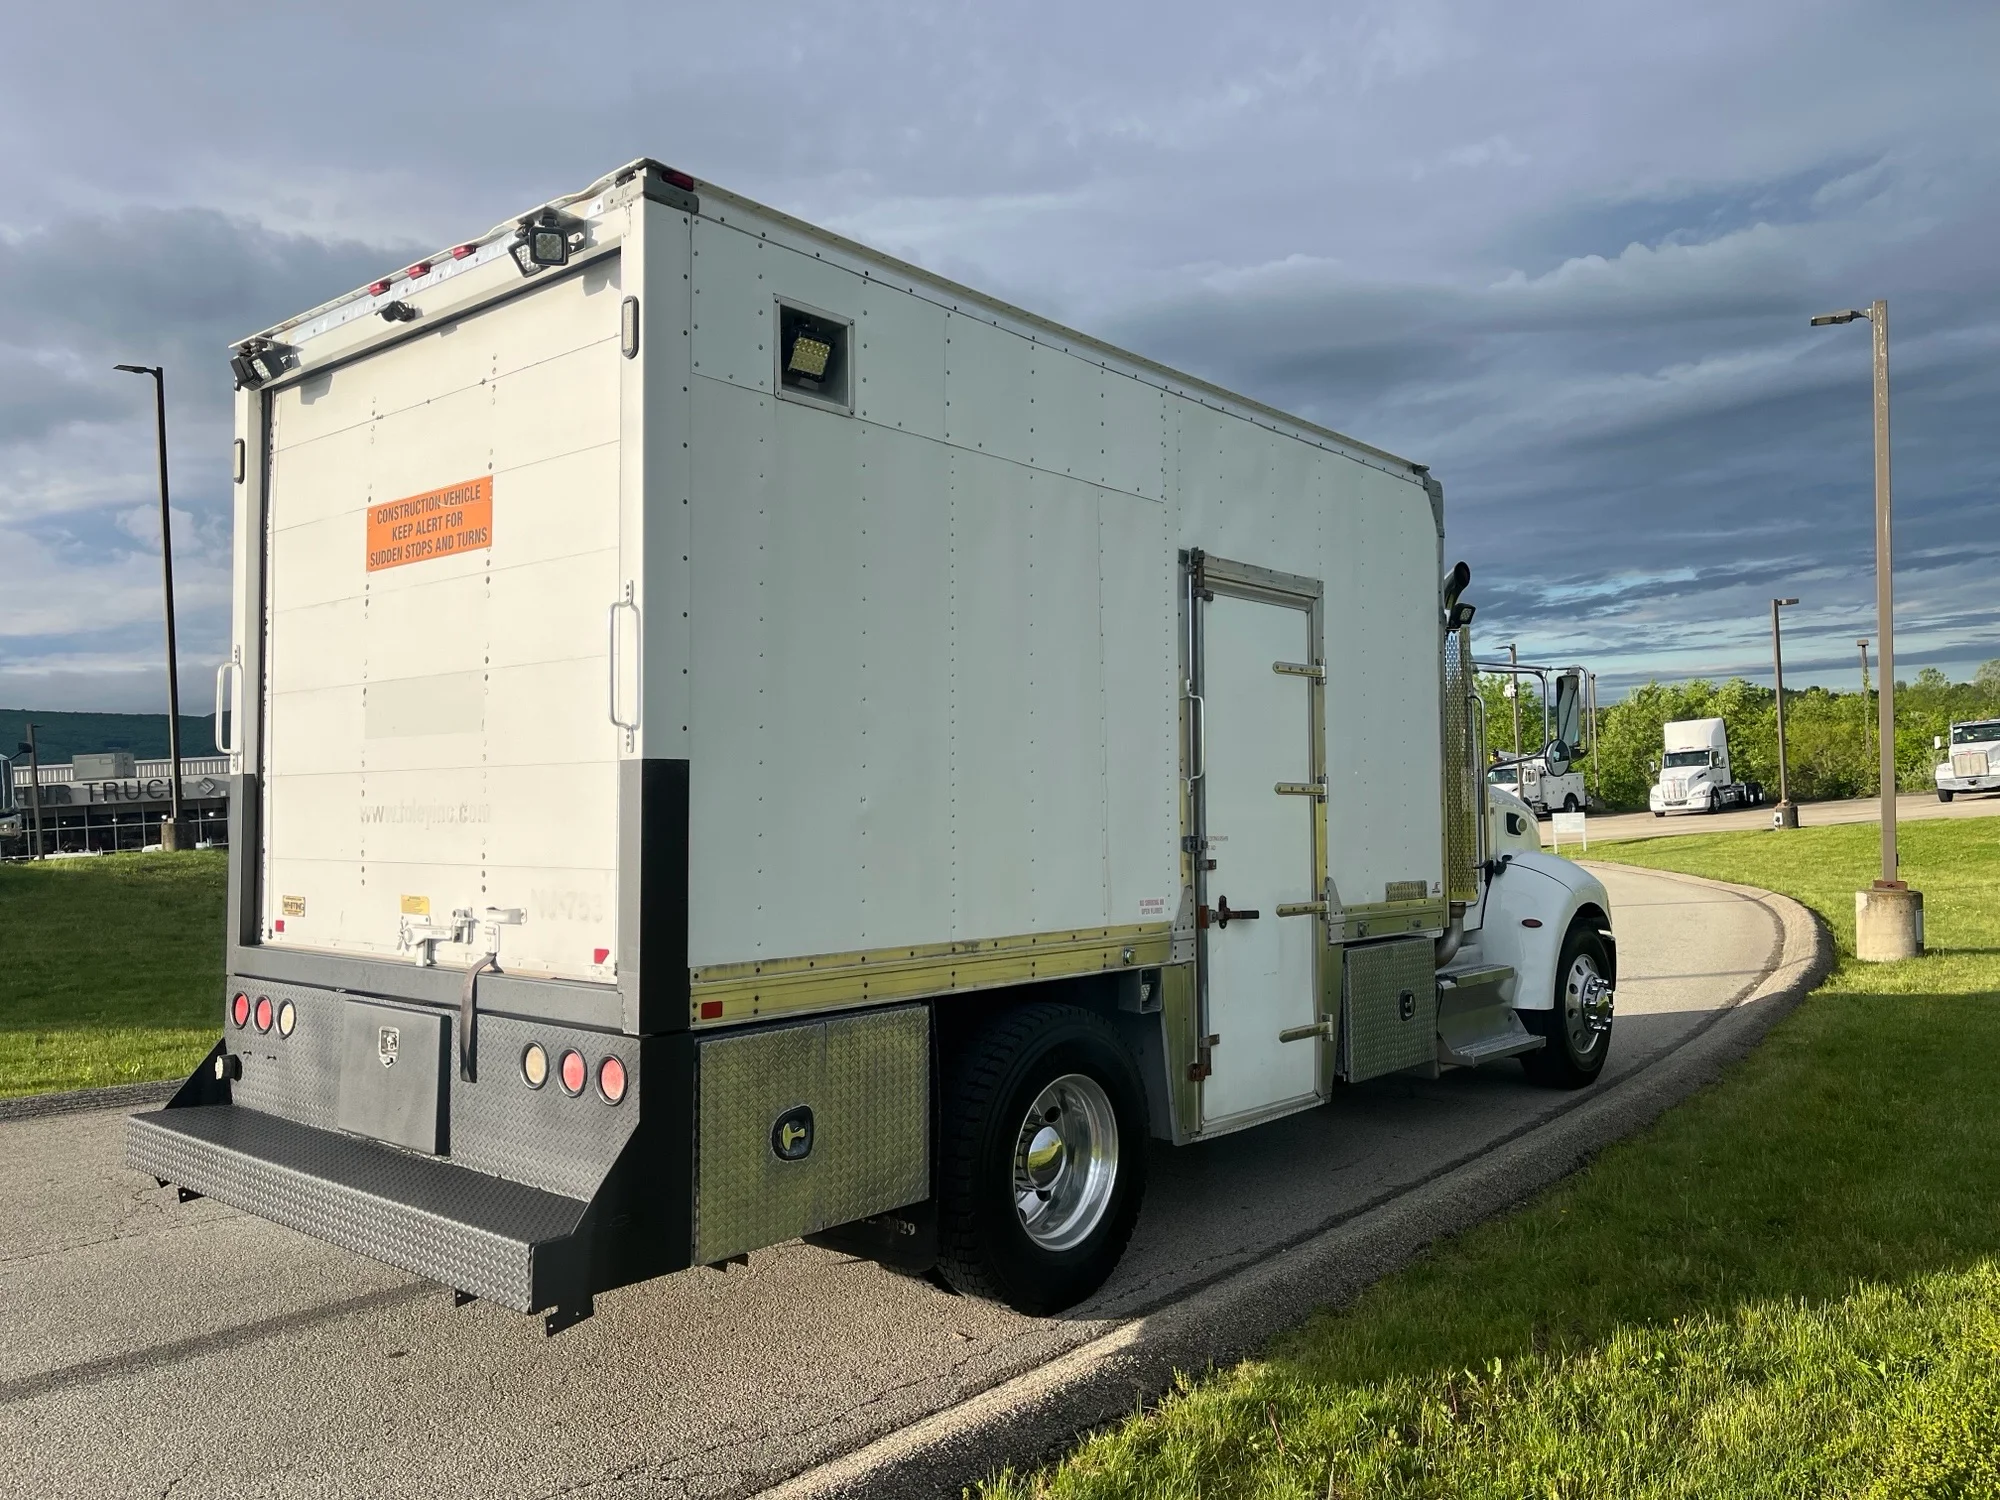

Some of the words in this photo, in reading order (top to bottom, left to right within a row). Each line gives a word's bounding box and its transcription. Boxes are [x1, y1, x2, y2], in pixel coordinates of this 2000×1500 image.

[377, 495, 441, 524] CONSTRUCTION
[443, 484, 481, 506] VEHICLE
[392, 523, 413, 542] KEEP
[415, 516, 443, 536] ALERT
[445, 511, 463, 528] FOR
[370, 546, 402, 566] SUDDEN
[405, 540, 432, 559] STOPS
[435, 535, 454, 553] AND
[457, 527, 488, 547] TURNS
